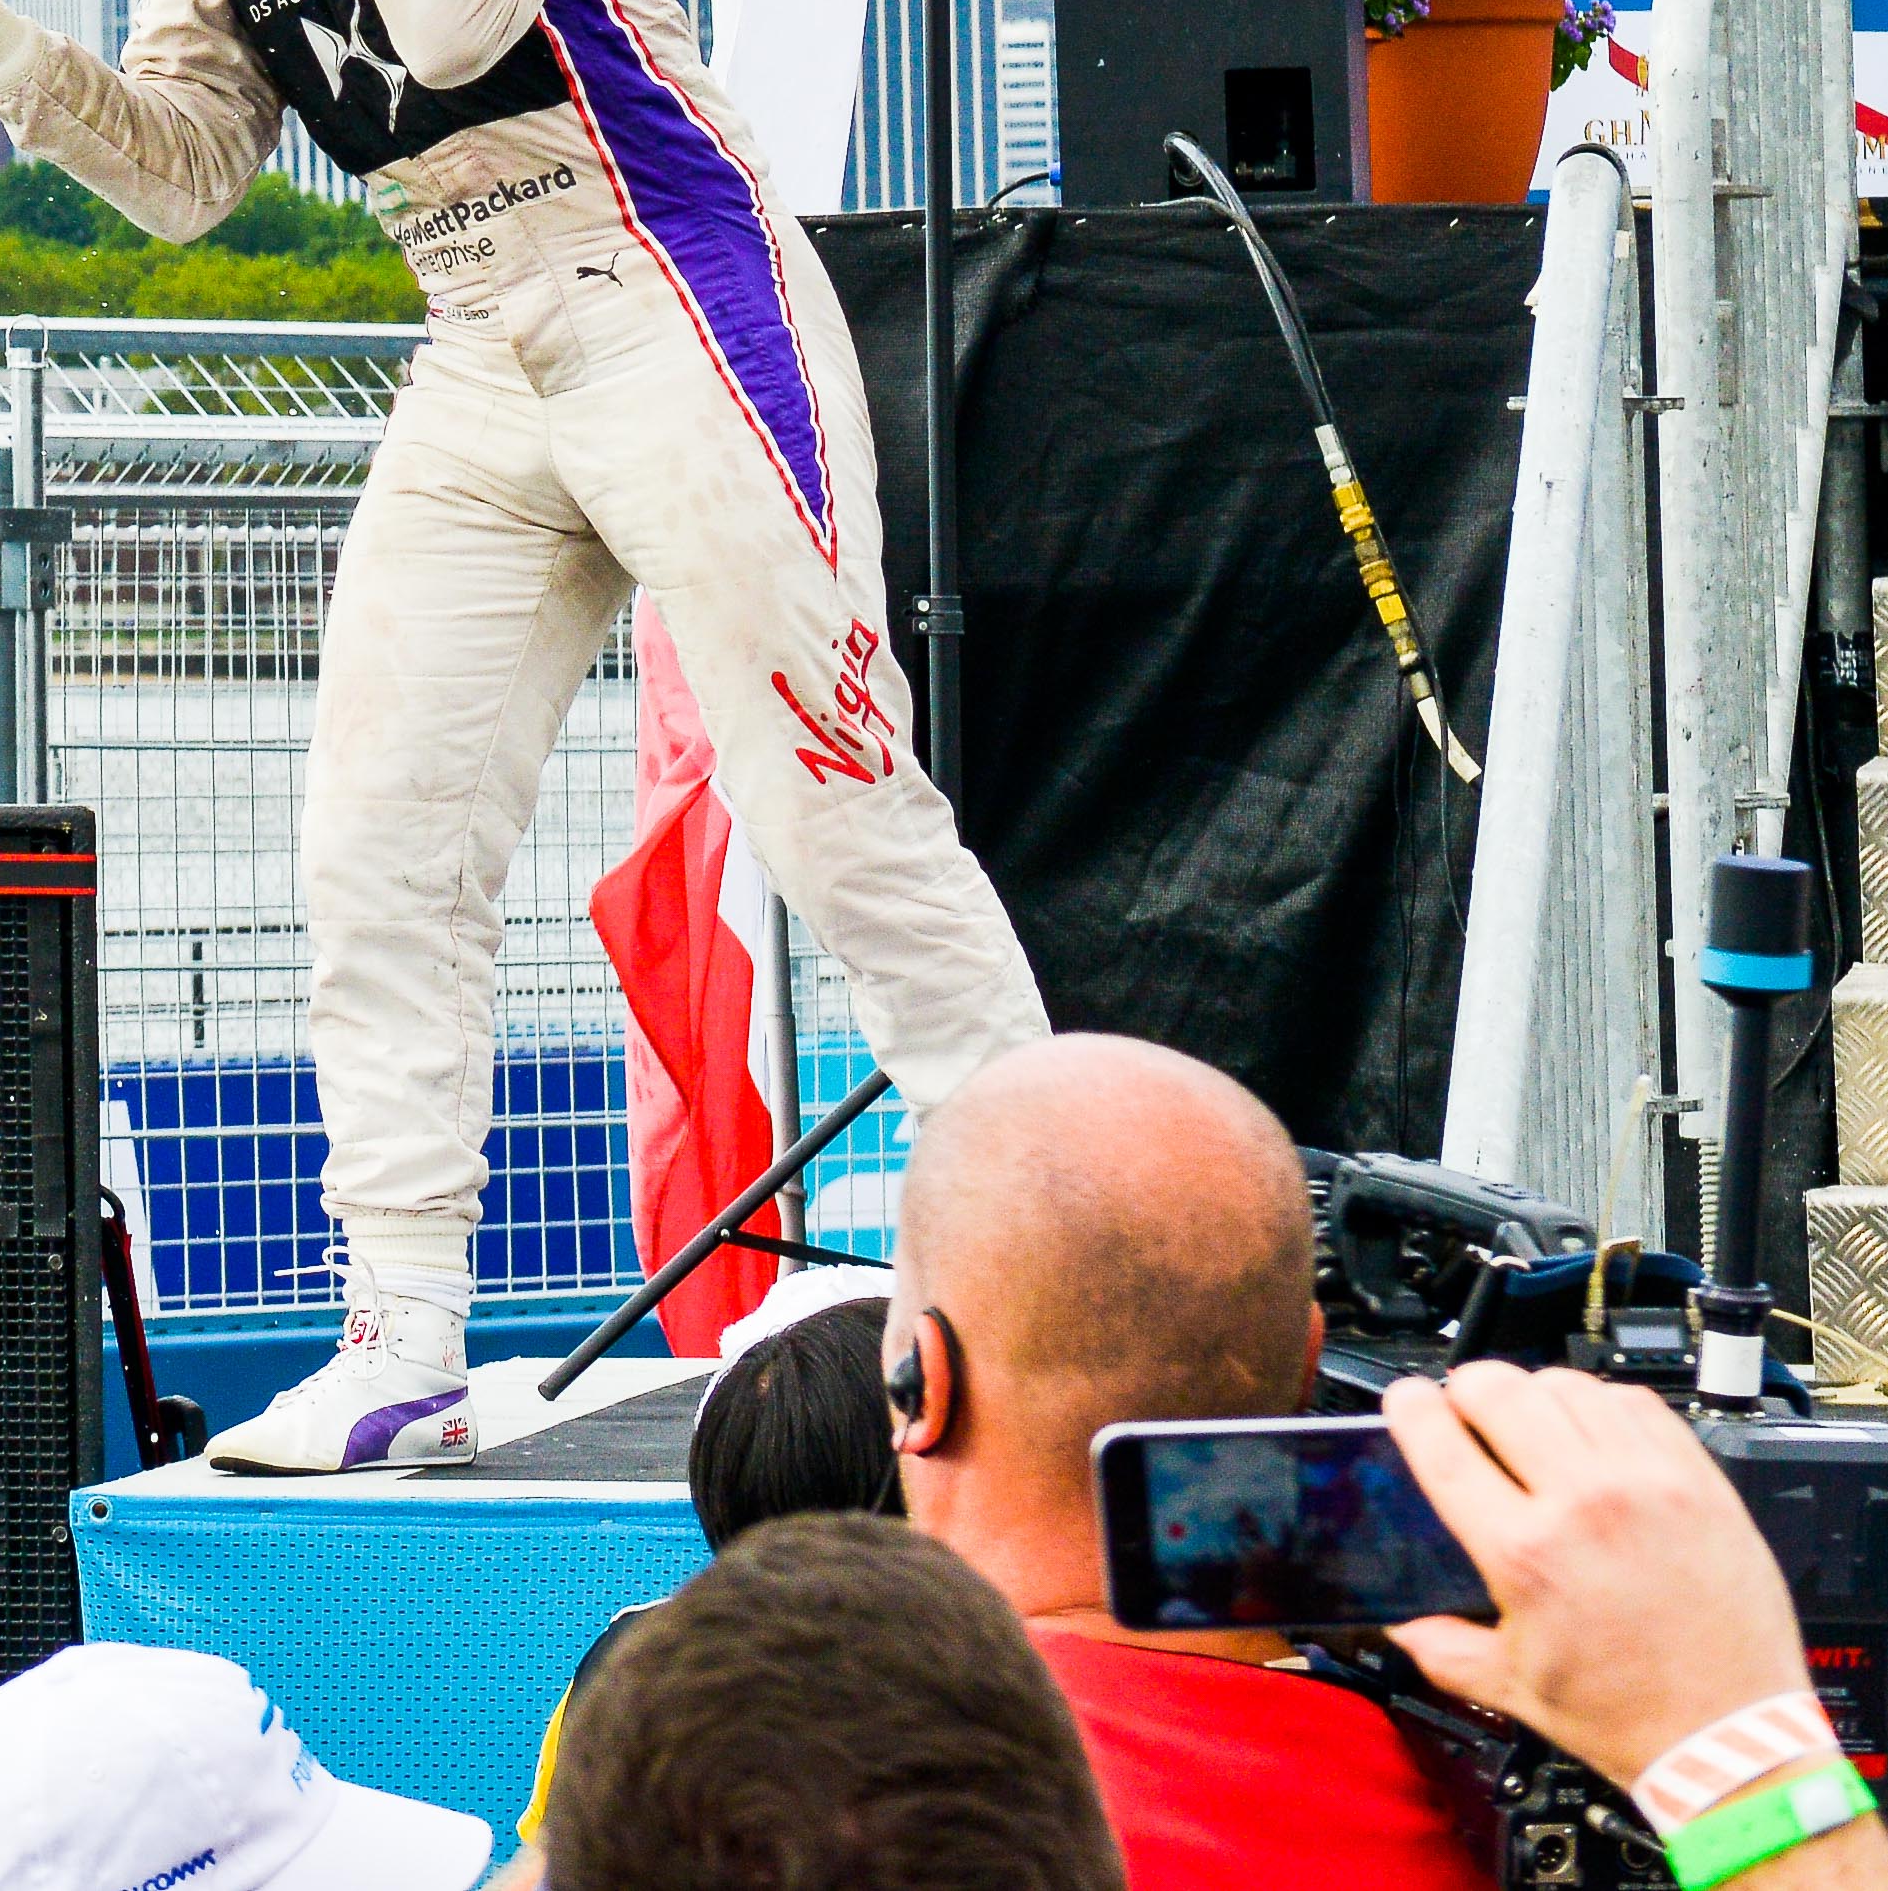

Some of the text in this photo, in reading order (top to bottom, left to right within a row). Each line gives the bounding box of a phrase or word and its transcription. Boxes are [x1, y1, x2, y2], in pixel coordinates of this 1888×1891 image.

[448, 162, 577, 231] Packard
[464, 309, 490, 321] BIRD
[770, 618, 896, 785] Virgin
